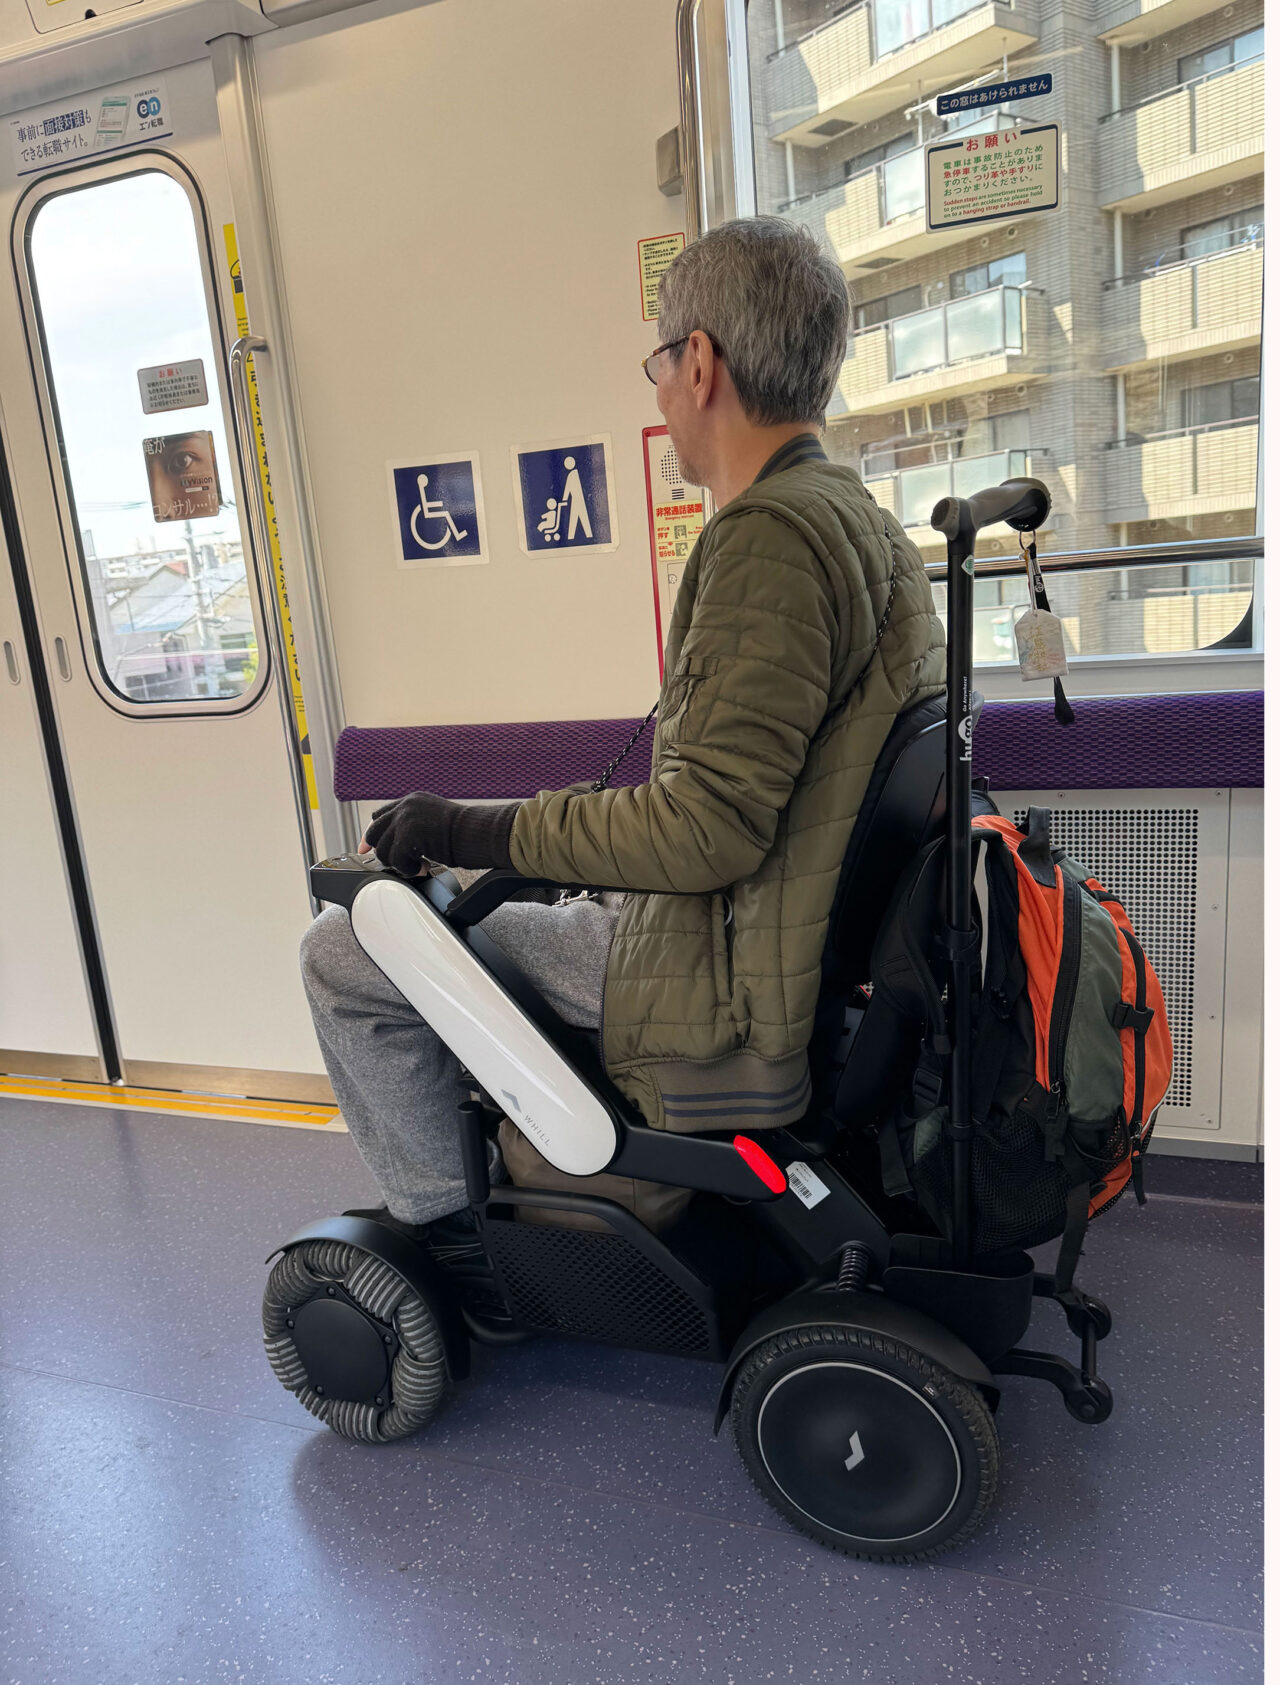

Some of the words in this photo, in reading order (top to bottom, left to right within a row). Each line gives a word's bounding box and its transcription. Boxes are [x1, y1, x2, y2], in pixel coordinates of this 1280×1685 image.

[940, 79, 1048, 110] この窓はあけられません
[138, 98, 160, 116] en
[966, 132, 1017, 151] お願い
[943, 144, 1043, 170] 電車は事故防止のため
[943, 154, 1043, 179] 急停車することがありま
[944, 197, 963, 206] Sudden
[964, 195, 978, 204] stops
[987, 188, 1016, 199] sometimes
[1016, 184, 1043, 194] necessary
[950, 202, 971, 212] prevent
[980, 196, 1002, 206] accident
[1011, 192, 1030, 202] please
[1030, 190, 1043, 198] hold
[962, 206, 984, 217] hanging
[986, 203, 1000, 213] strap
[656, 503, 703, 517] 非常通話装置
[524, 1114, 550, 1146] WHILL
